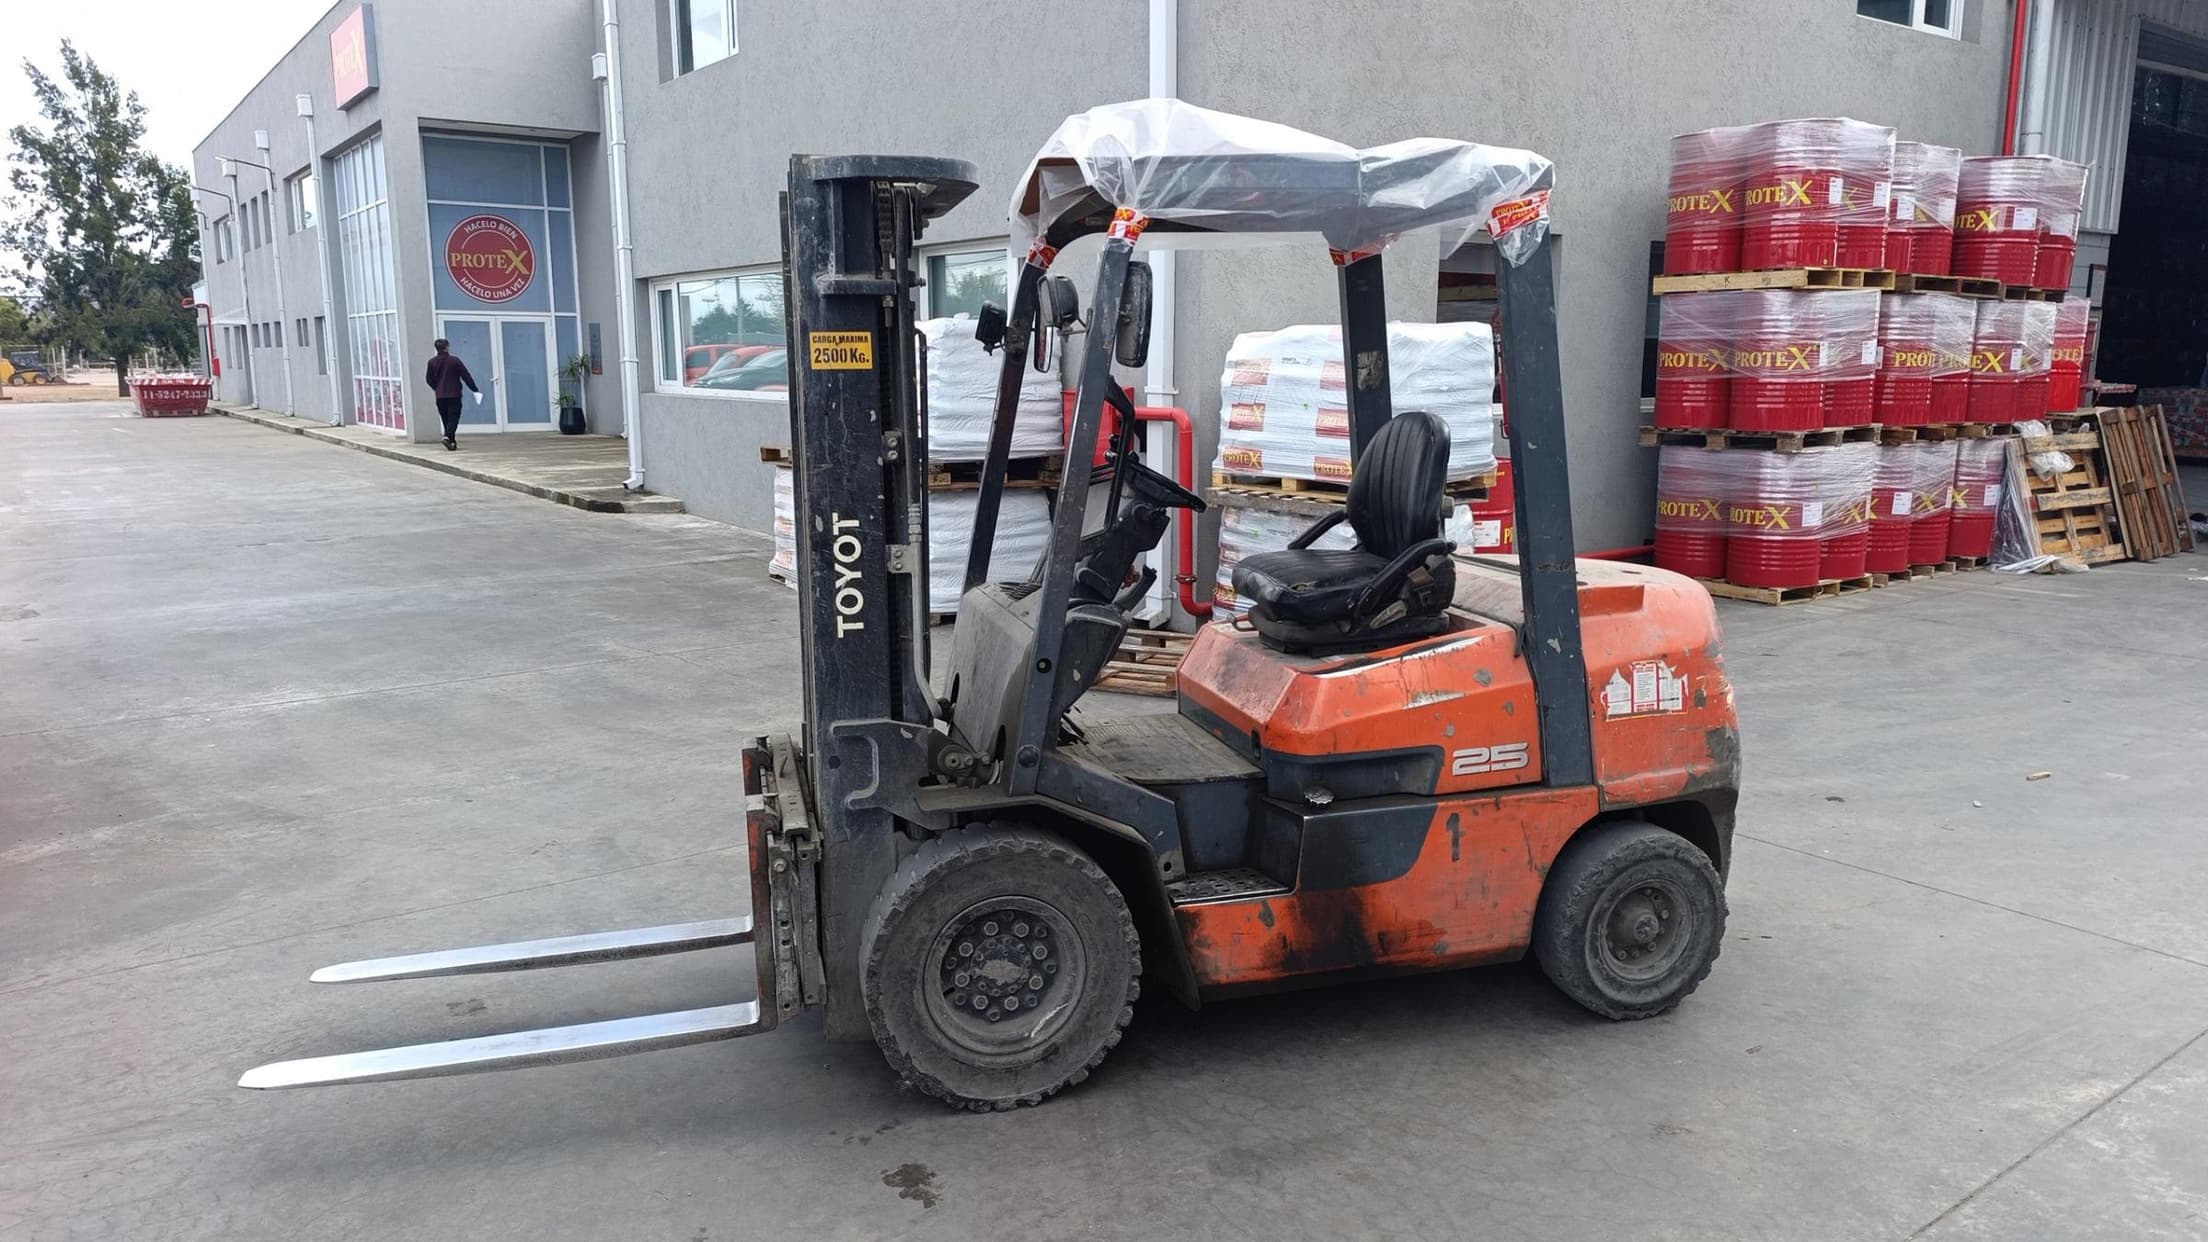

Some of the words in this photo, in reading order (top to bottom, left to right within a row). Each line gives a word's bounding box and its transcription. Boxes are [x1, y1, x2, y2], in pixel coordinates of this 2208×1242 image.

[1745, 180, 1813, 206] ROTEX
[464, 220, 497, 234] HACELO
[498, 223, 518, 240] BIEN
[450, 249, 530, 275] PROTEX
[460, 276, 492, 299] HACELO
[493, 287, 512, 299] UNA
[511, 278, 526, 292] VEZ
[812, 335, 837, 344] CARGA
[814, 347, 848, 363] 2500
[1660, 498, 1723, 521] ROTEX
[832, 511, 864, 639] TOYOT
[1452, 742, 1530, 776] 25
[1446, 812, 1460, 862] 1
